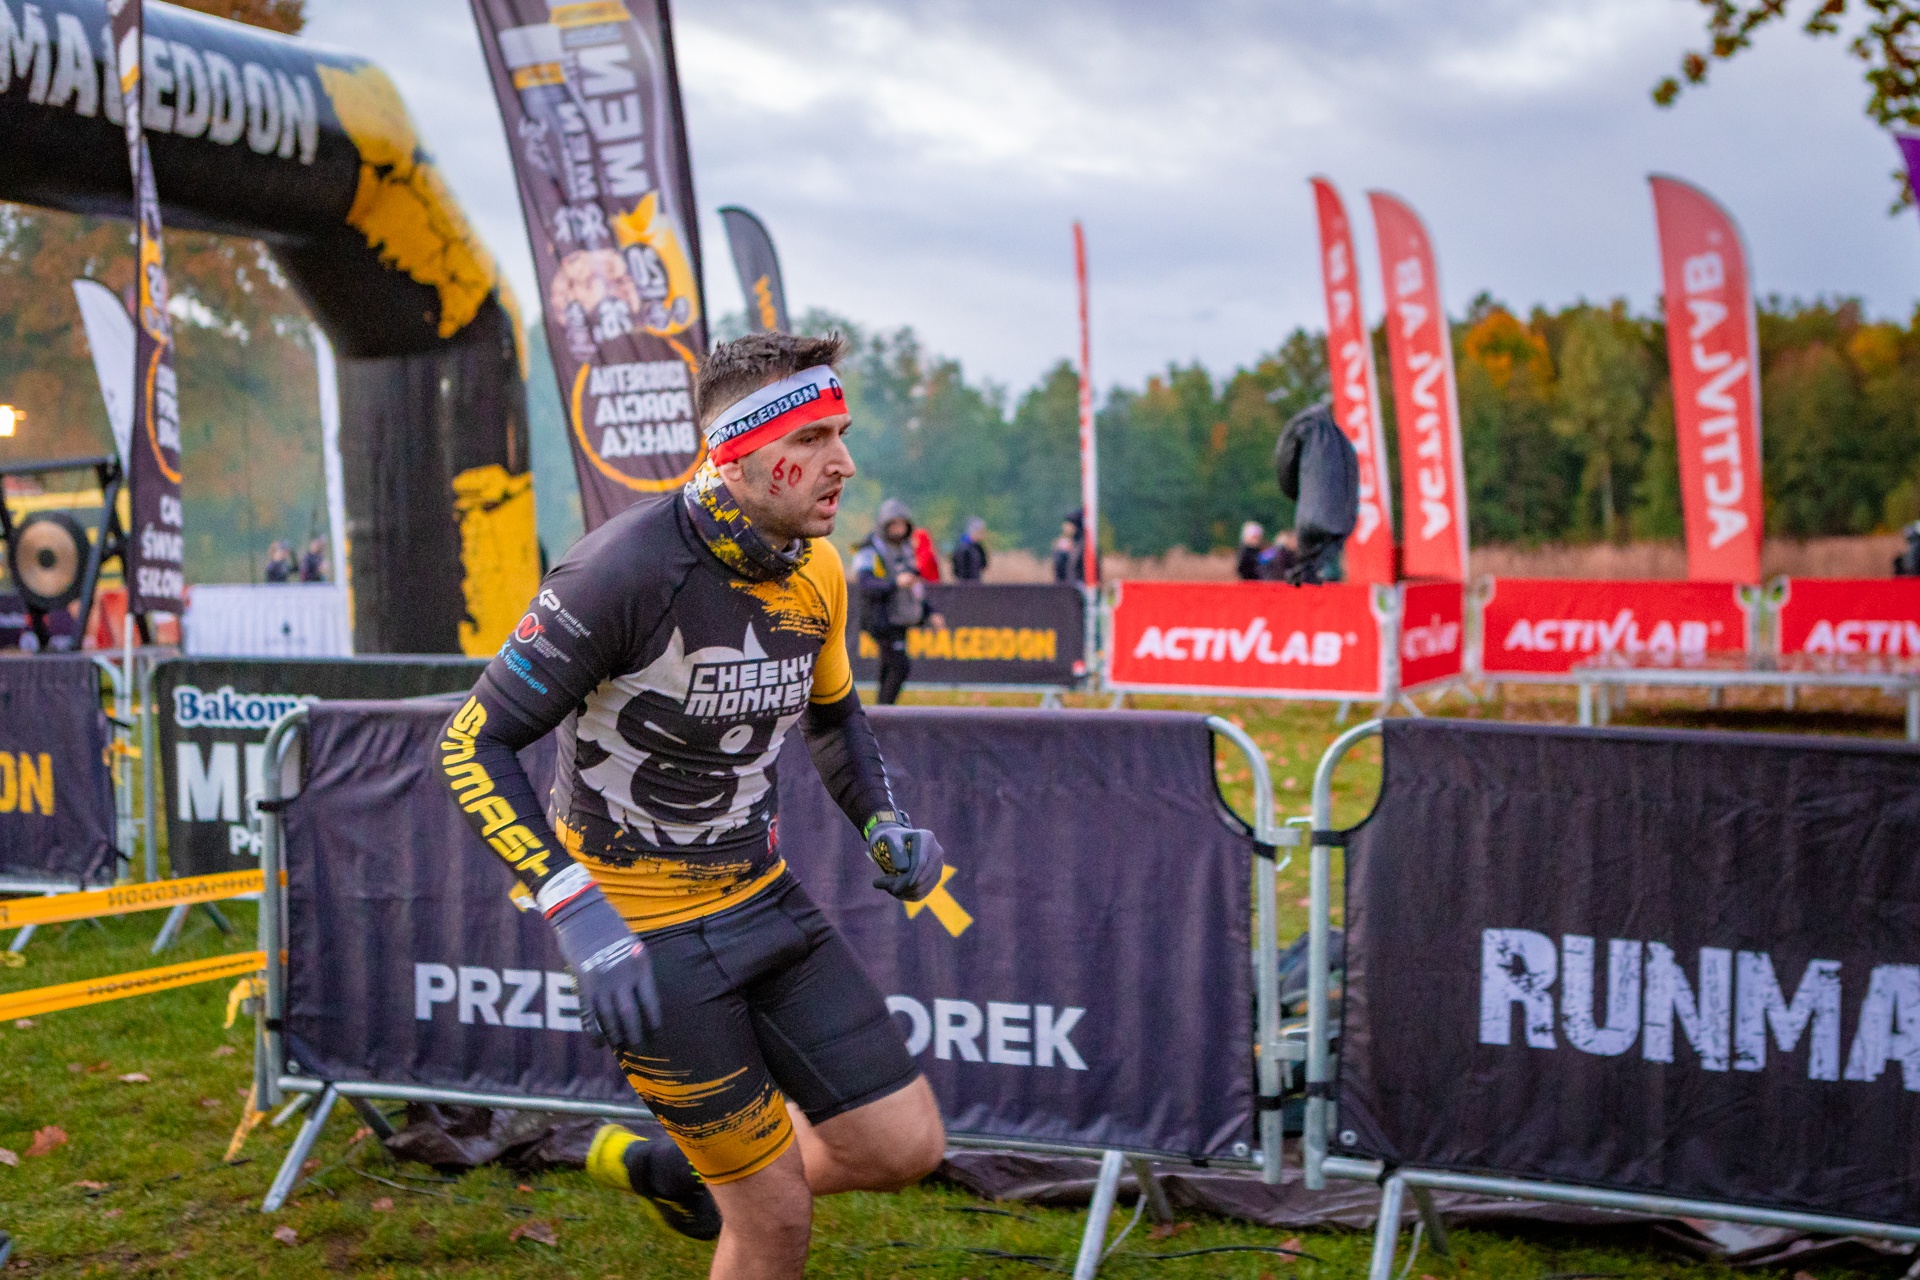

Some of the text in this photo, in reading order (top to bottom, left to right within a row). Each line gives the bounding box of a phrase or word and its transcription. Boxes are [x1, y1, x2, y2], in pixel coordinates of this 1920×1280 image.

[771, 456, 803, 488] 60
[1134, 617, 1344, 667] ACTIVLAB
[1505, 609, 1710, 657] ACTIVLAB
[692, 652, 813, 692] CHEEKY
[684, 675, 814, 717] MONKEY
